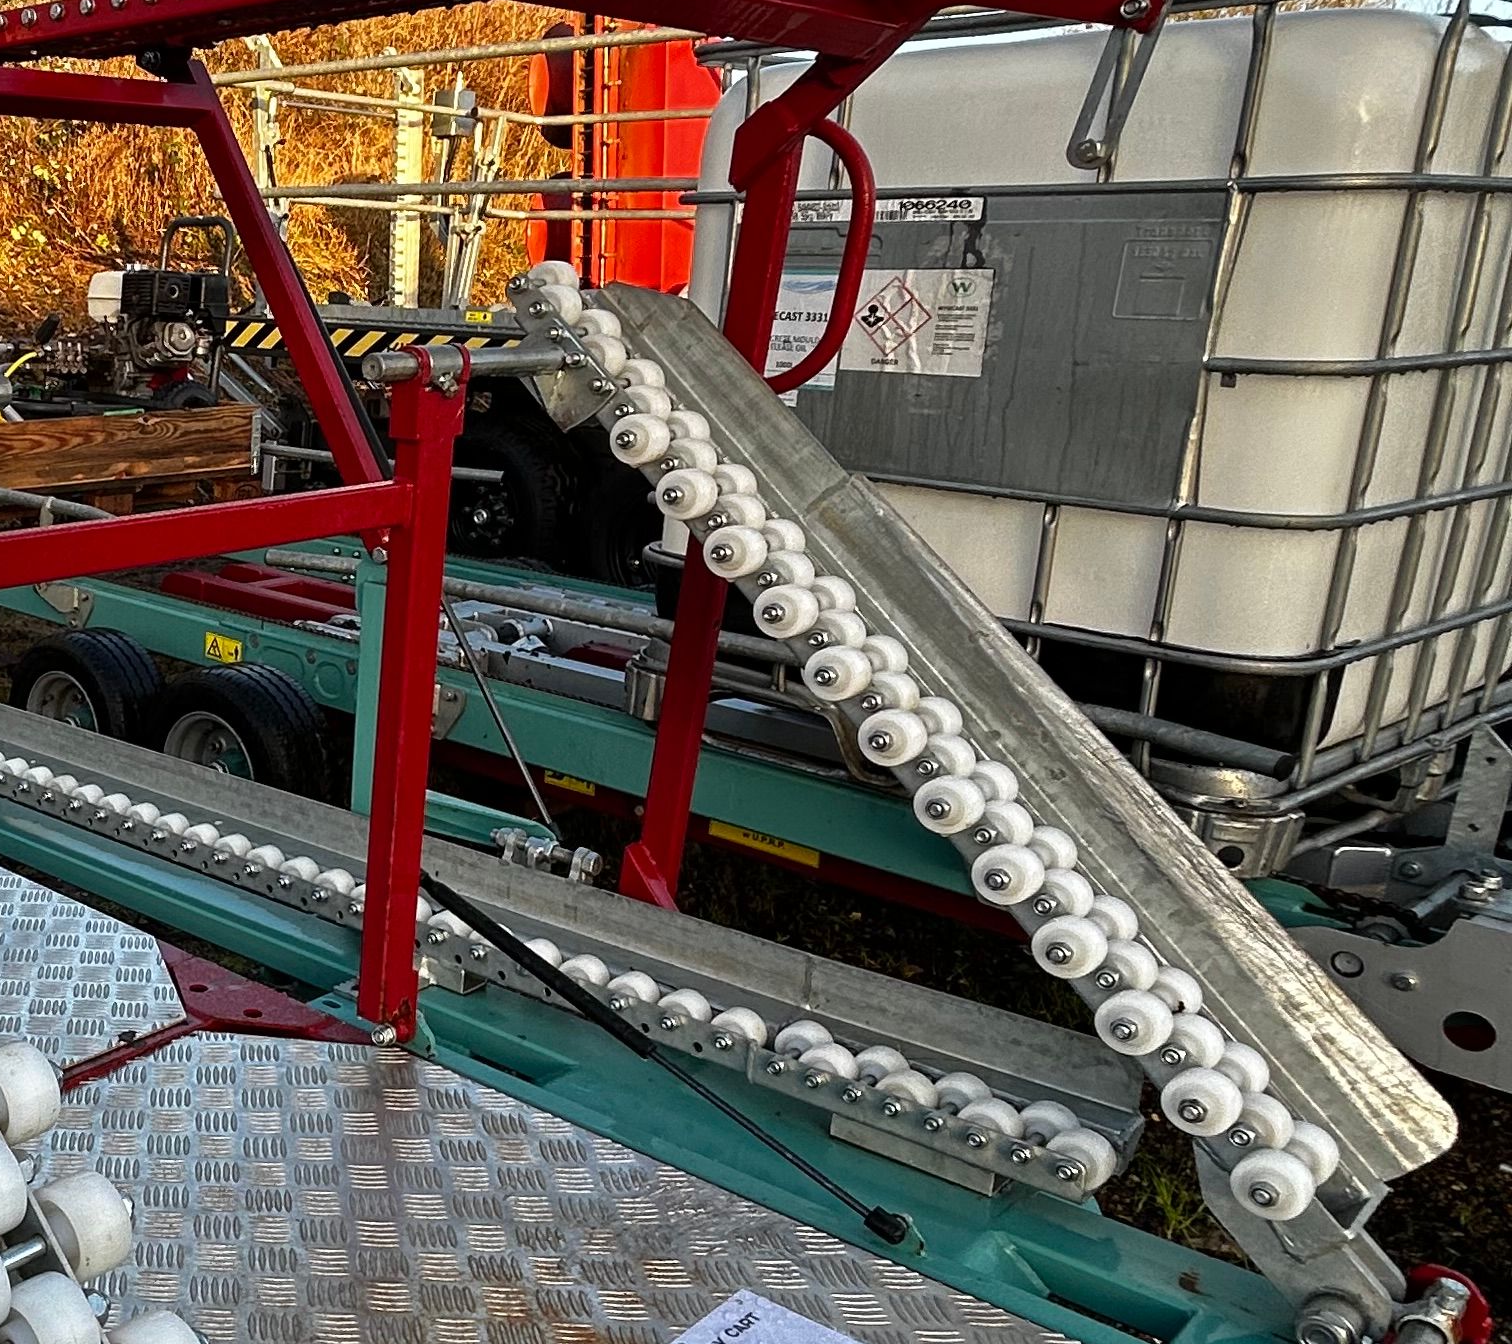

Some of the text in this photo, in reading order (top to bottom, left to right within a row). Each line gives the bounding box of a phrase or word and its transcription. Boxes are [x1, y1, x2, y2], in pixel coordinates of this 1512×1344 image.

[773, 310, 829, 323] ECAST 3331
[724, 1311, 761, 1339] CART
